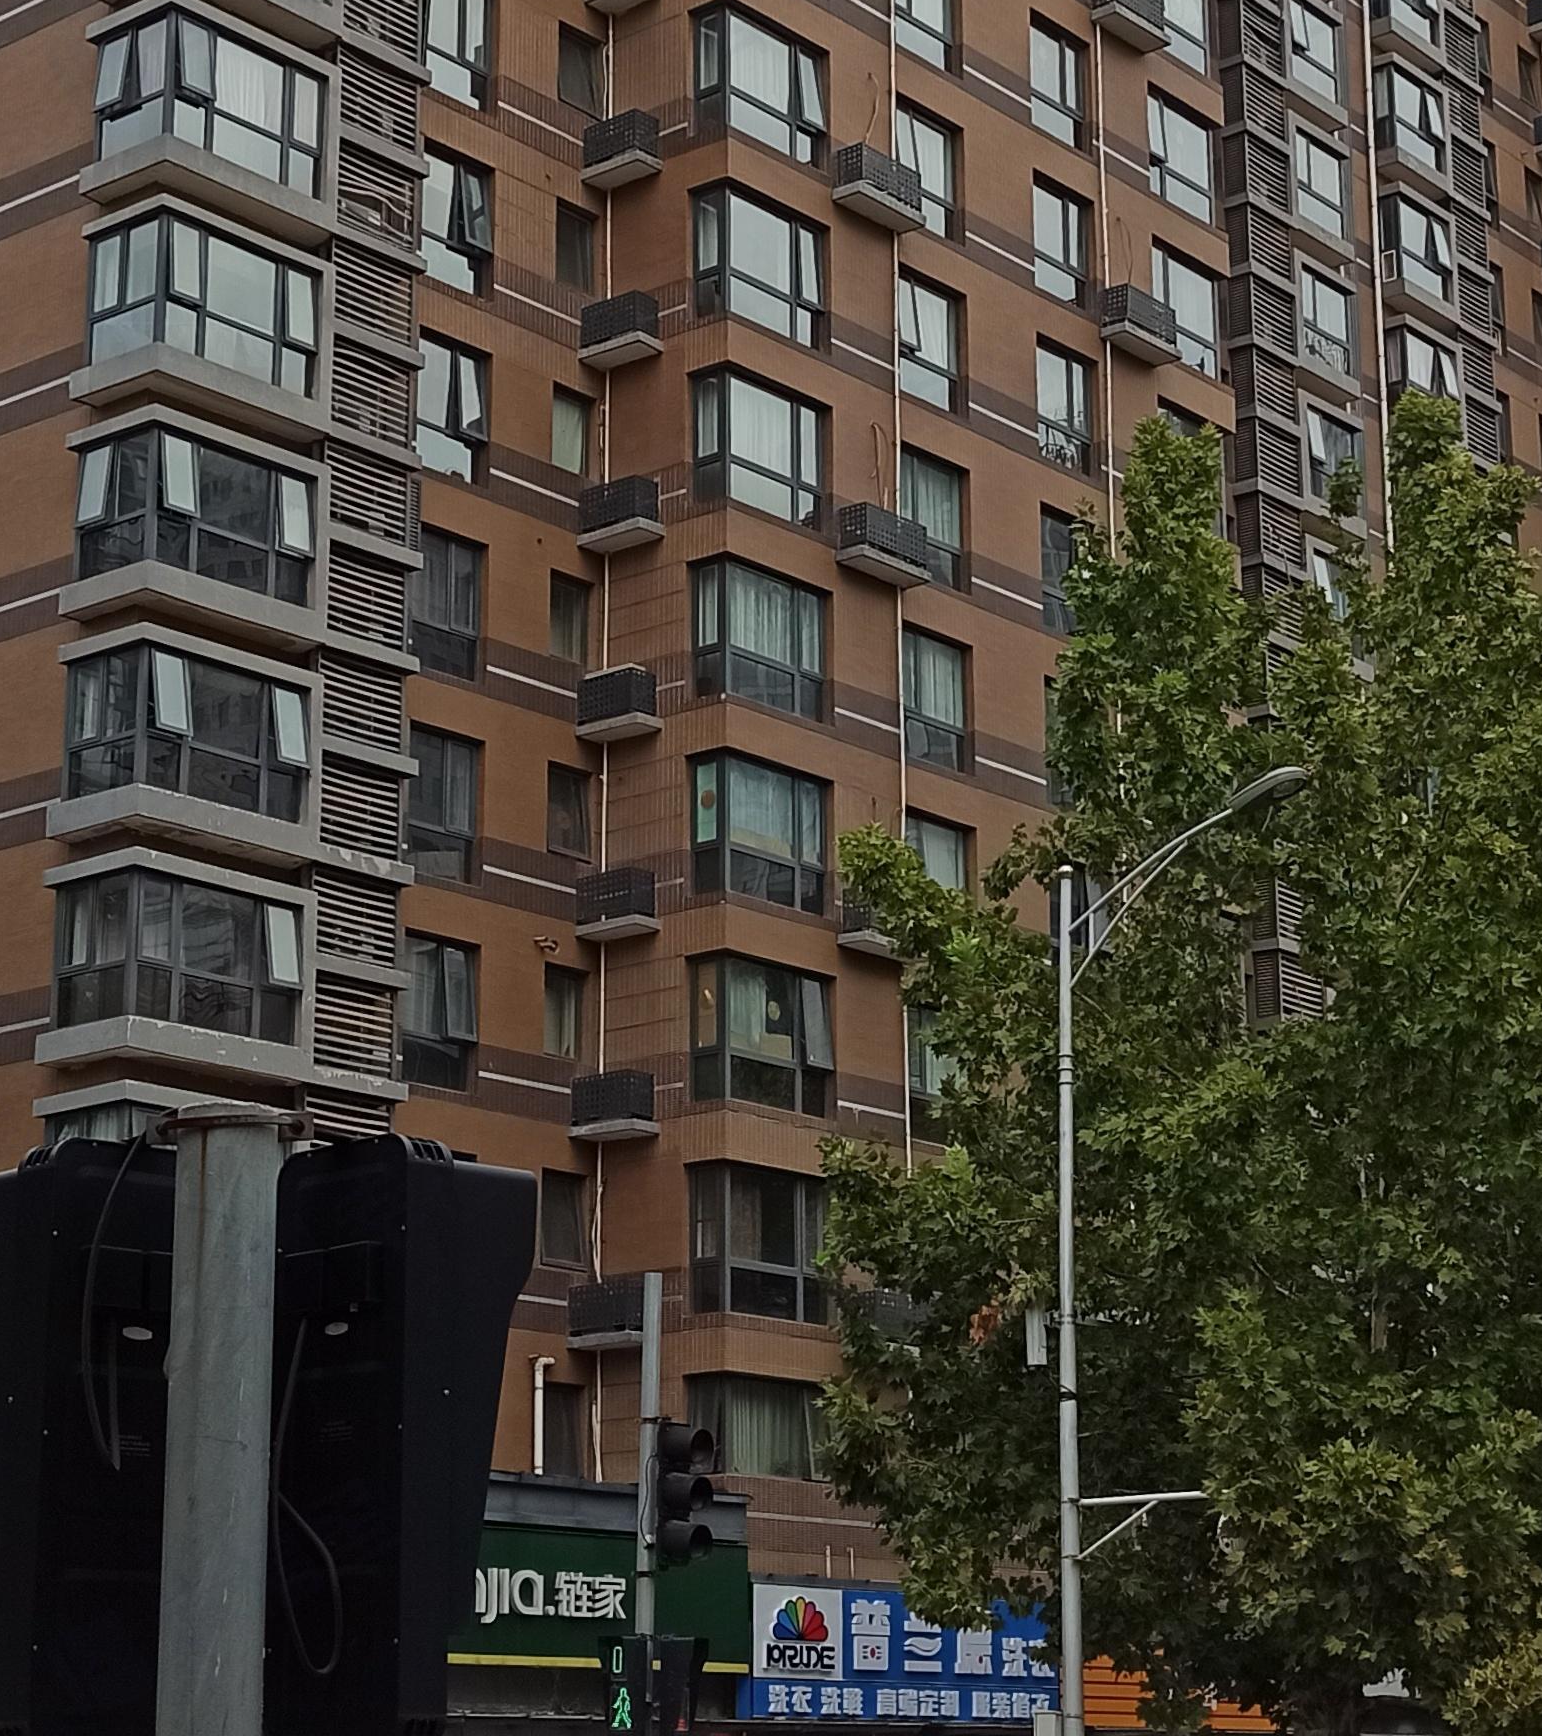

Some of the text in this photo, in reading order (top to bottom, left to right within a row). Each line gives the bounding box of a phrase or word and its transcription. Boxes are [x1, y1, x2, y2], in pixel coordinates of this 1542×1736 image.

[768, 1684, 813, 1713] 洗衣
[876, 1689, 960, 1717] 高端定制
